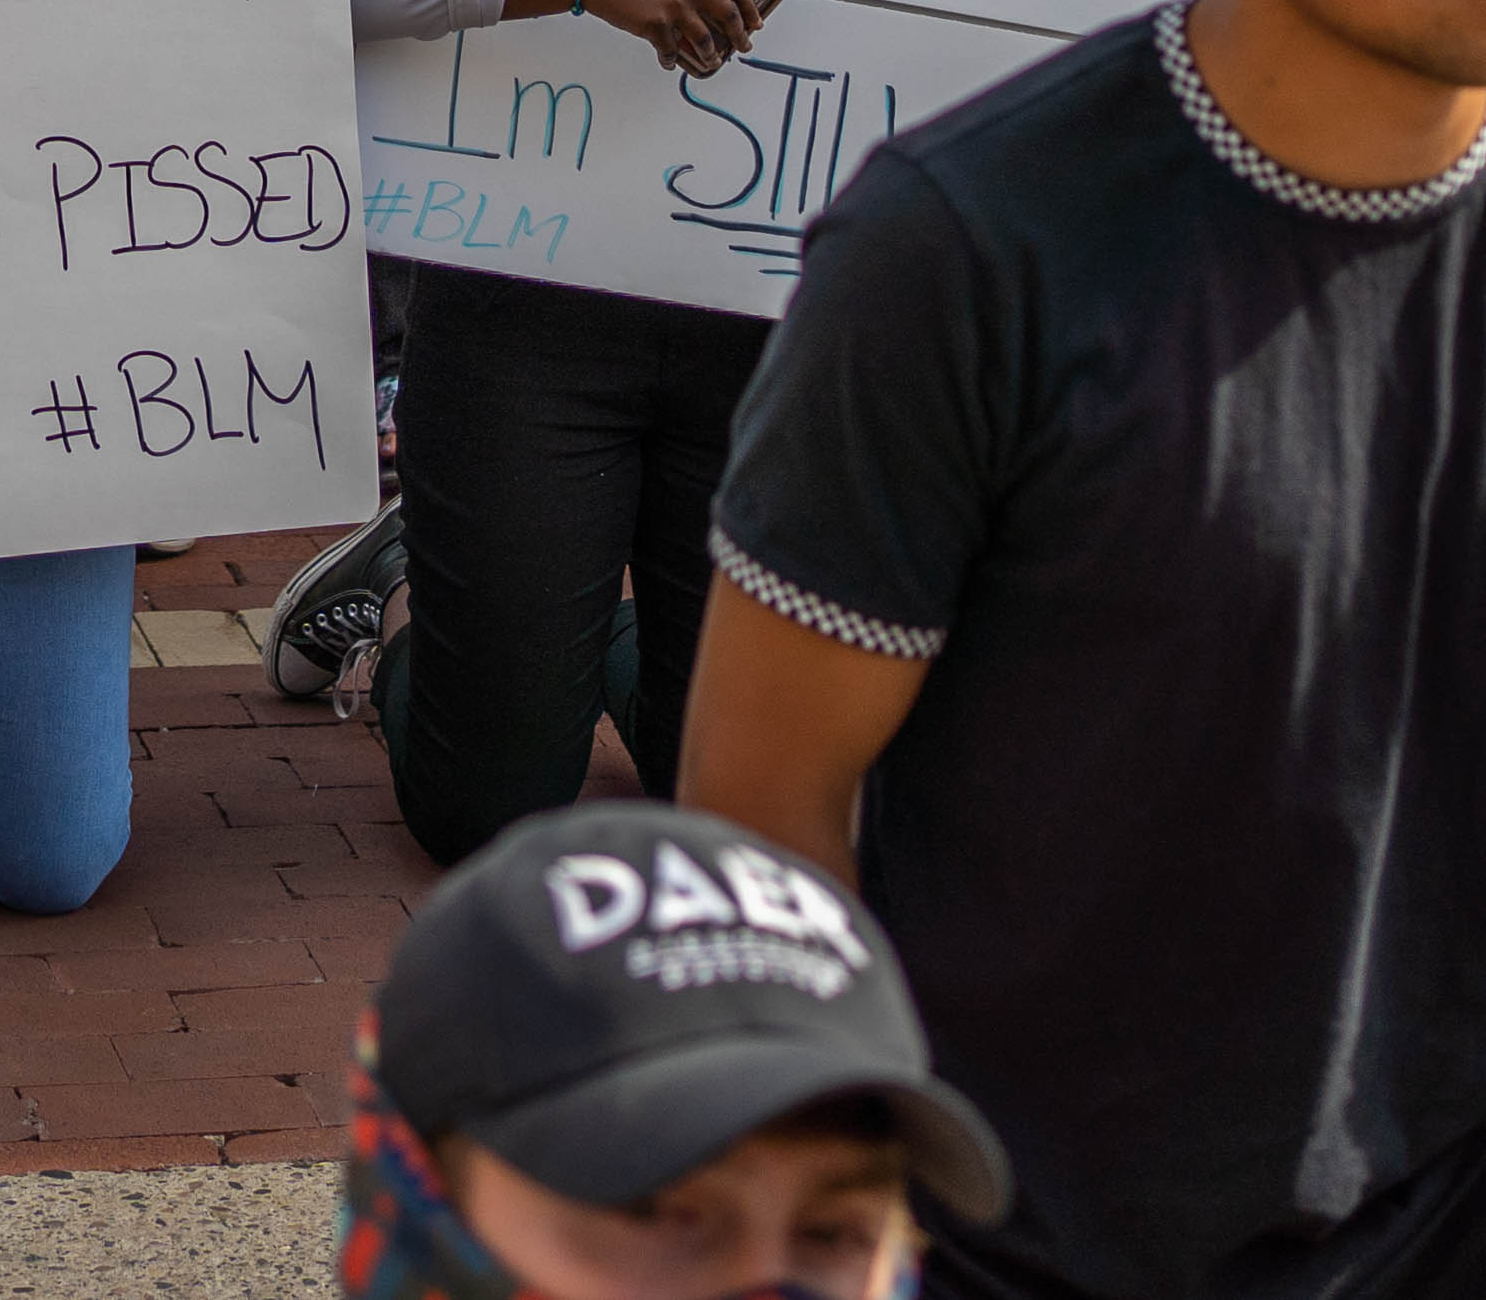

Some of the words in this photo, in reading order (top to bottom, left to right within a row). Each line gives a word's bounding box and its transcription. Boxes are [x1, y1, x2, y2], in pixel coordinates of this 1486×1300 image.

[35, 135, 349, 271] PISSED
[363, 177, 572, 264] #BLM
[30, 348, 326, 471] #BLM
